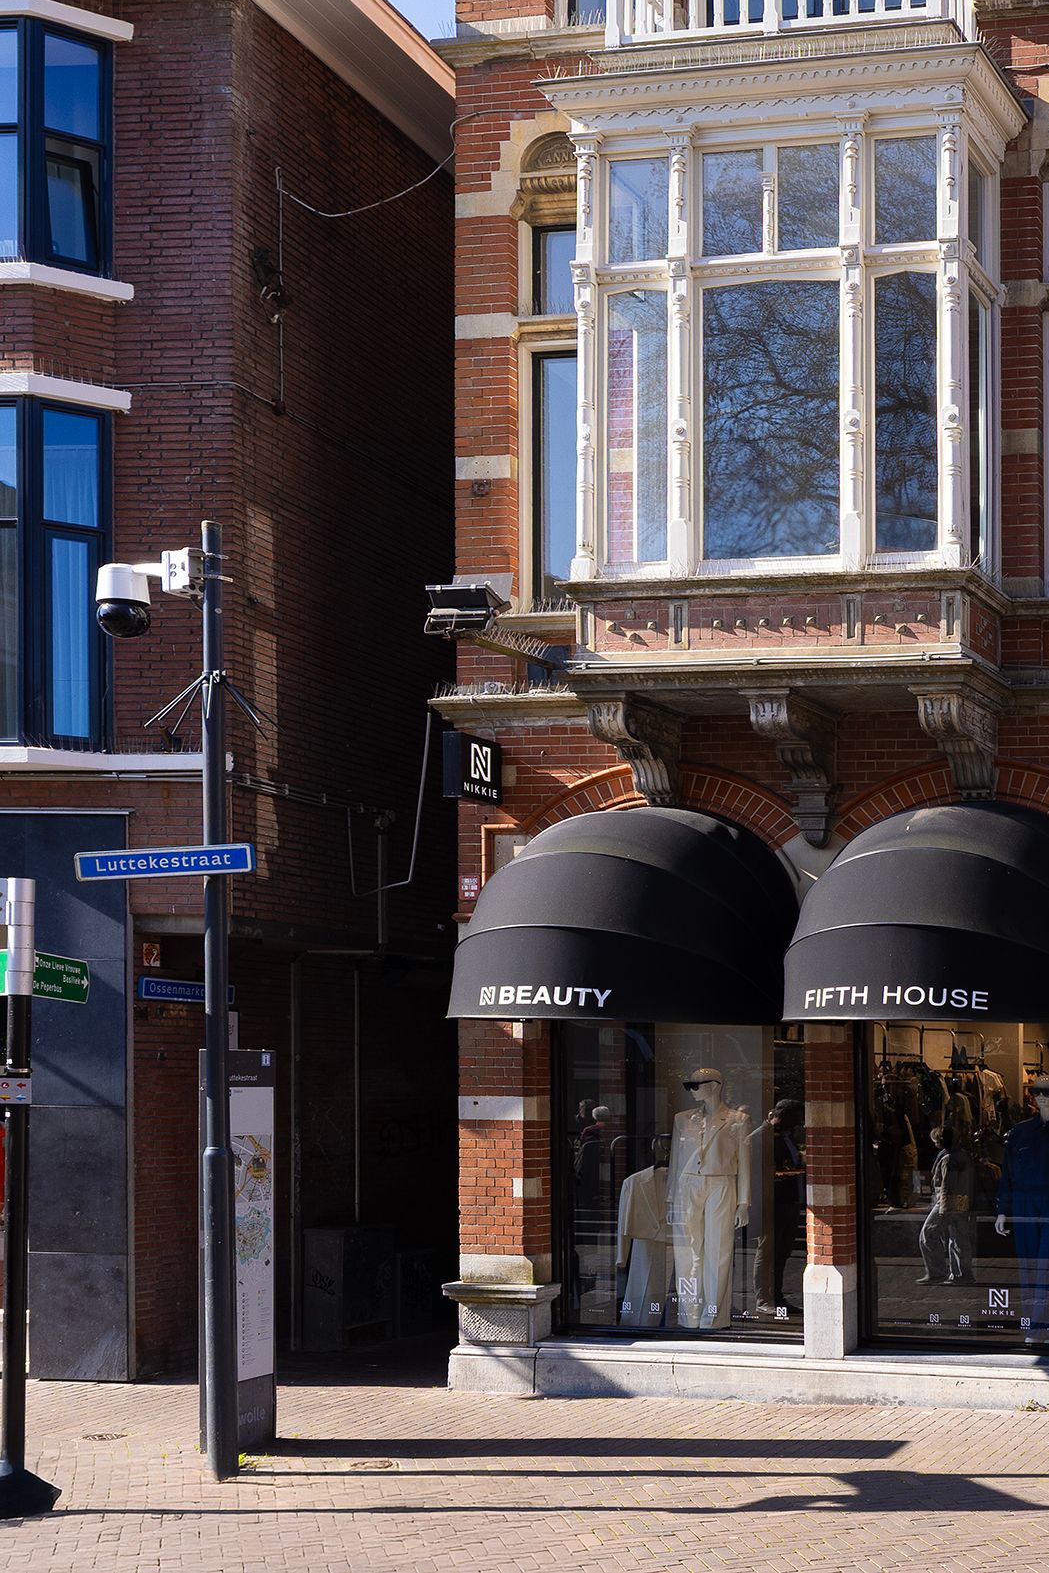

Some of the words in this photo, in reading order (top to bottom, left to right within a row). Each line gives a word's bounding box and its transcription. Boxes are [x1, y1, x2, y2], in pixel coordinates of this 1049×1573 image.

[463, 781, 498, 799] NIKKIE
[95, 853, 231, 872] Luttekestraat
[40, 958, 51, 969] Onze
[52, 961, 65, 971] Lieve
[65, 963, 81, 975] Vrouwe
[41, 981, 63, 994] Peperbus
[63, 974, 81, 986] Basiliek
[498, 985, 612, 1008] BEAUTY
[804, 985, 869, 1010] FIFTH
[882, 985, 989, 1011] HOUSE
[981, 1309, 1016, 1317] NIKKIE
[240, 1406, 266, 1426] wolle
